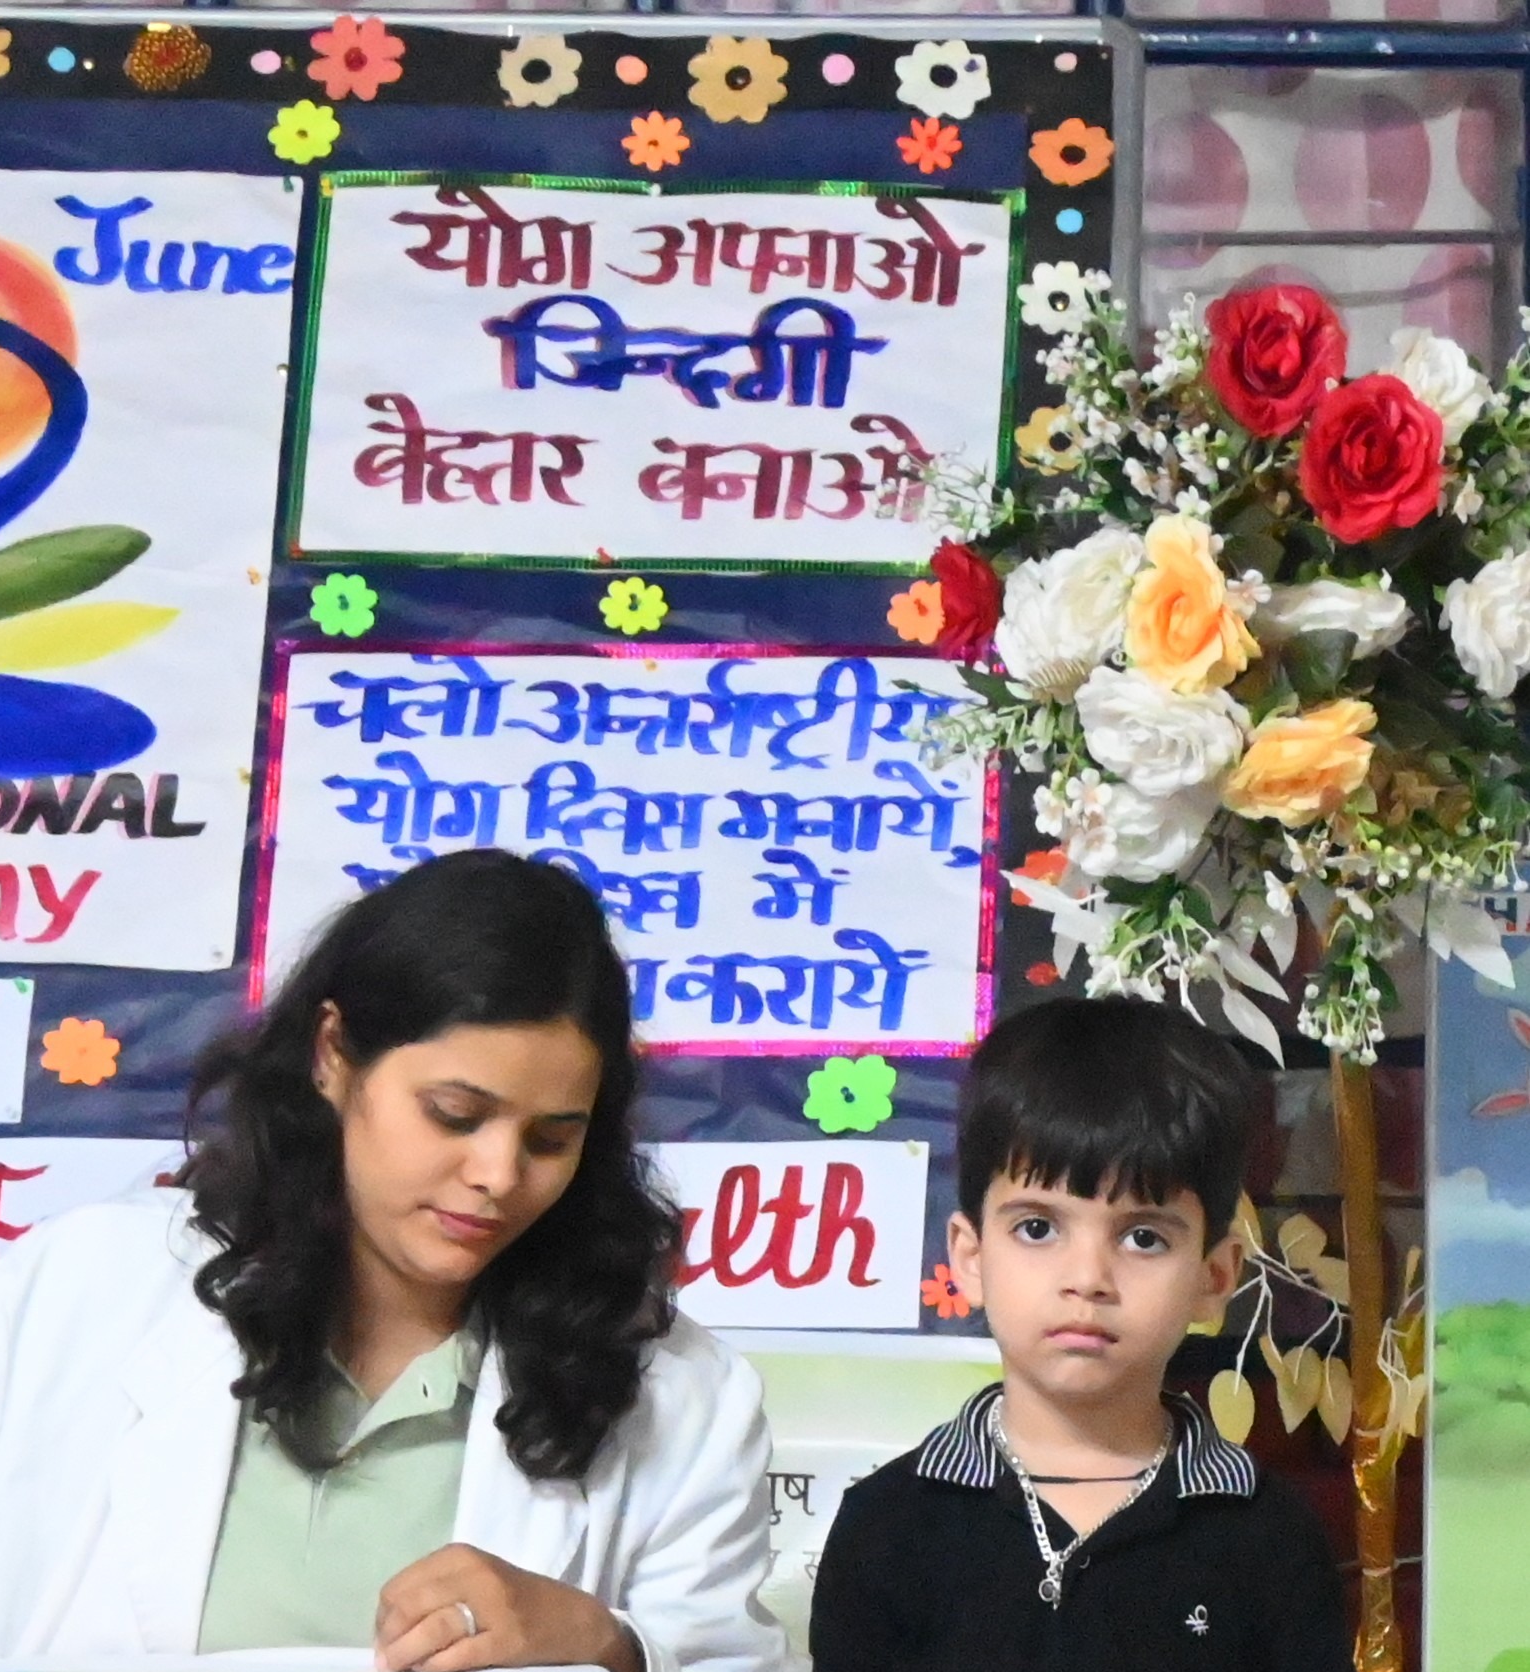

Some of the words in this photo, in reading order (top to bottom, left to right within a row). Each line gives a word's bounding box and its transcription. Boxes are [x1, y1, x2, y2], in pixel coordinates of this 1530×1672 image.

[55, 196, 294, 295] June
[388, 184, 596, 289] योग
[604, 197, 986, 306] अपनाओ
[293, 653, 517, 743] चलो
[323, 750, 505, 846] योग
[521, 760, 715, 855] दिवस
[752, 849, 848, 925] में
